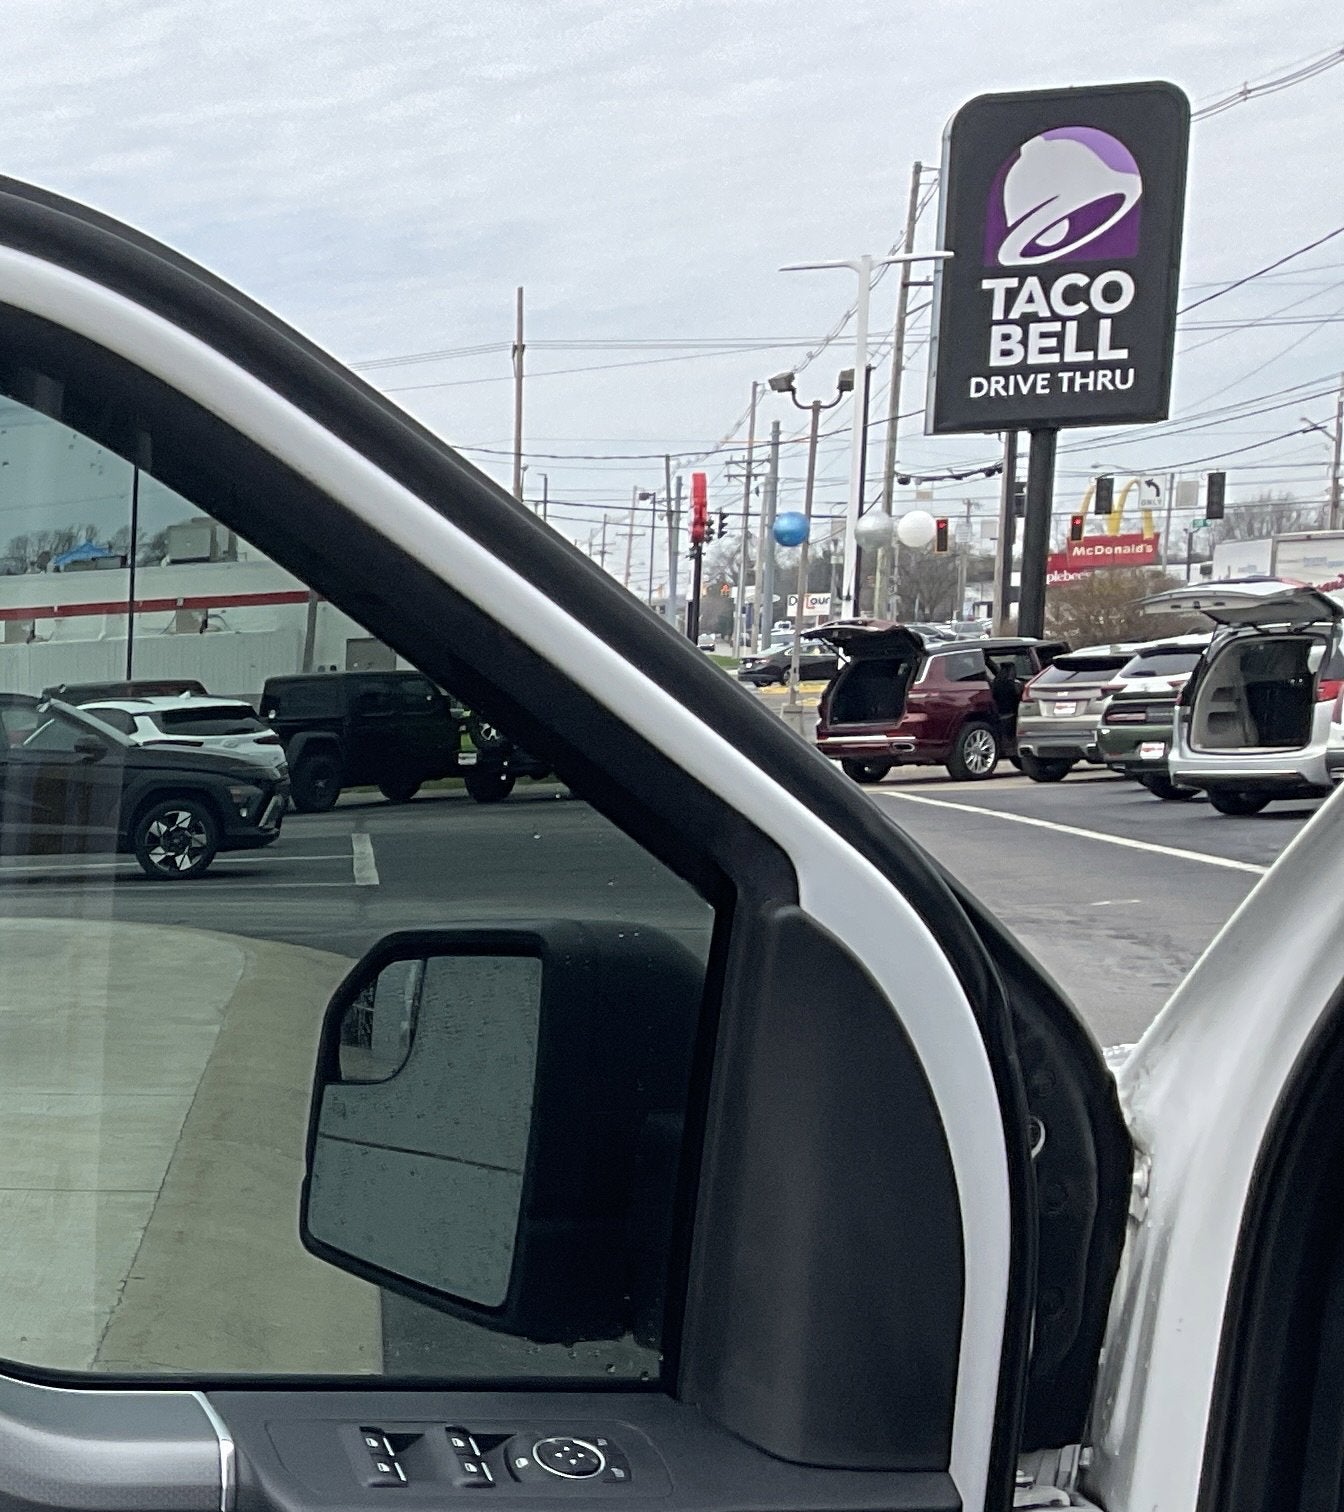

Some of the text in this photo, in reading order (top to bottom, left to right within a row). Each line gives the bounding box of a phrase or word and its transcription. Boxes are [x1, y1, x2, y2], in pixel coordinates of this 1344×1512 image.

[981, 270, 1135, 320] TACO
[989, 318, 1129, 367] BELL
[969, 368, 1135, 398] DRIVE THRU
[1072, 544, 1153, 557] McDonald's
